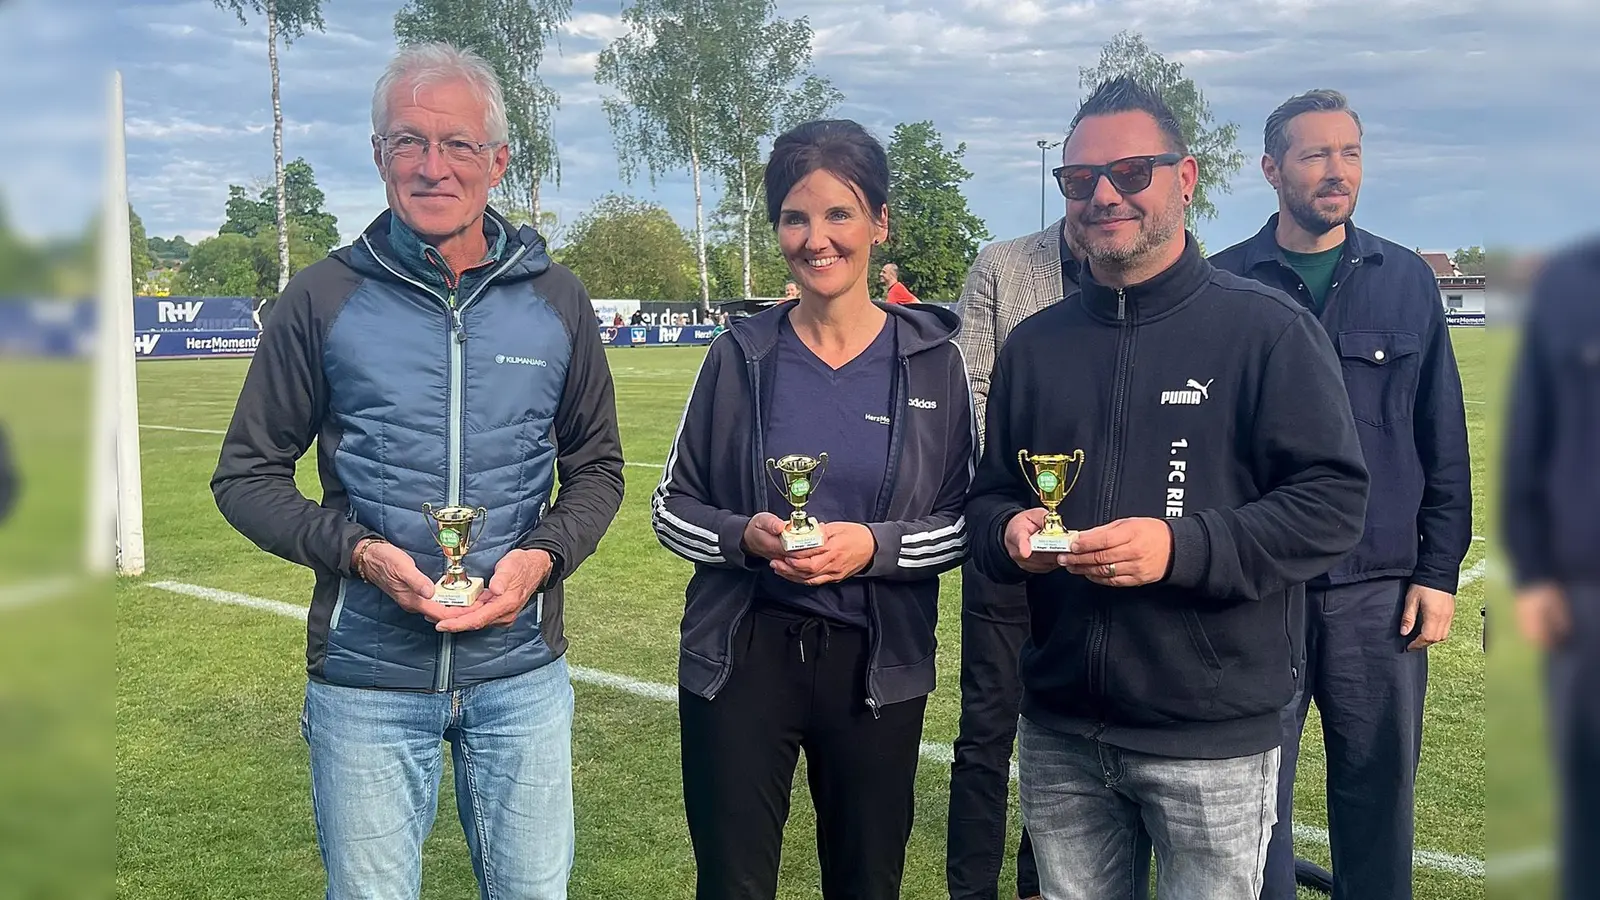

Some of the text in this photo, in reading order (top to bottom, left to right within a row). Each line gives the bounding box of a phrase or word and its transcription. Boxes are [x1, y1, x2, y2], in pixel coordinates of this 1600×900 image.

[158, 301, 204, 323] R+V
[658, 327, 683, 343] R+V
[133, 334, 161, 355] +V
[506, 356, 547, 367] KILIMANJARO
[1161, 390, 1201, 405] PUMA
[1165, 438, 1188, 519] 1. FC RIE
